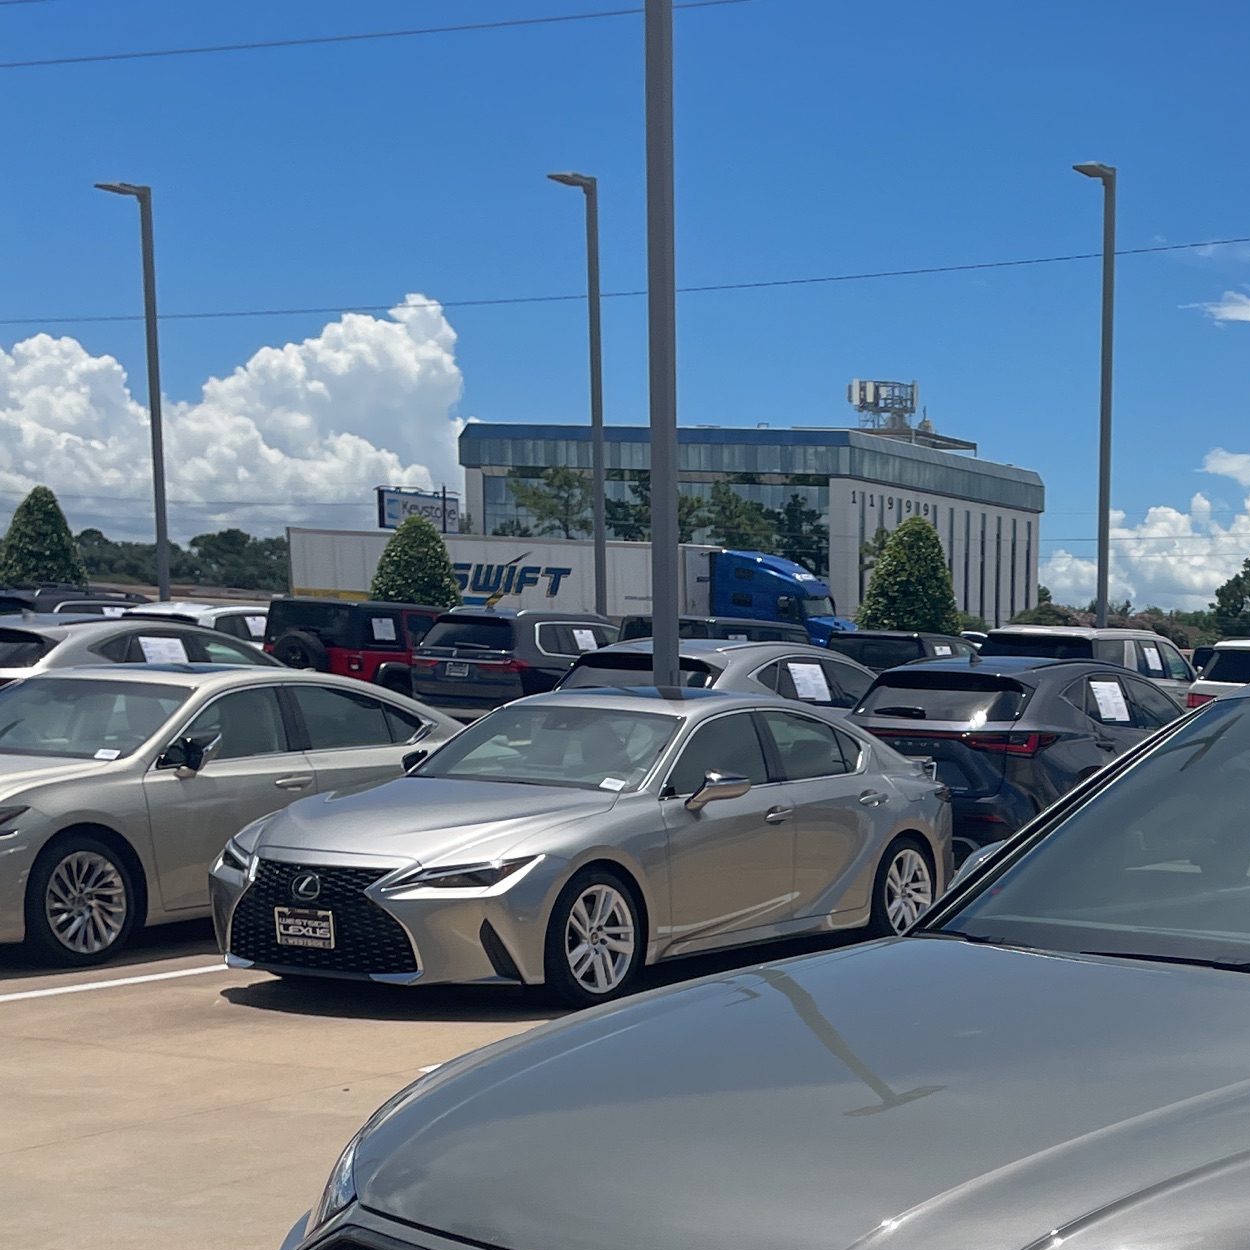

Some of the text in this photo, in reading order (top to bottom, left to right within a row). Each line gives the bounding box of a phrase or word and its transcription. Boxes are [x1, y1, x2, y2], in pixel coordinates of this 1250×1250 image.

[851, 490, 930, 517] 11999
[452, 562, 572, 599] SWIFT
[280, 924, 331, 939] LEXUS
